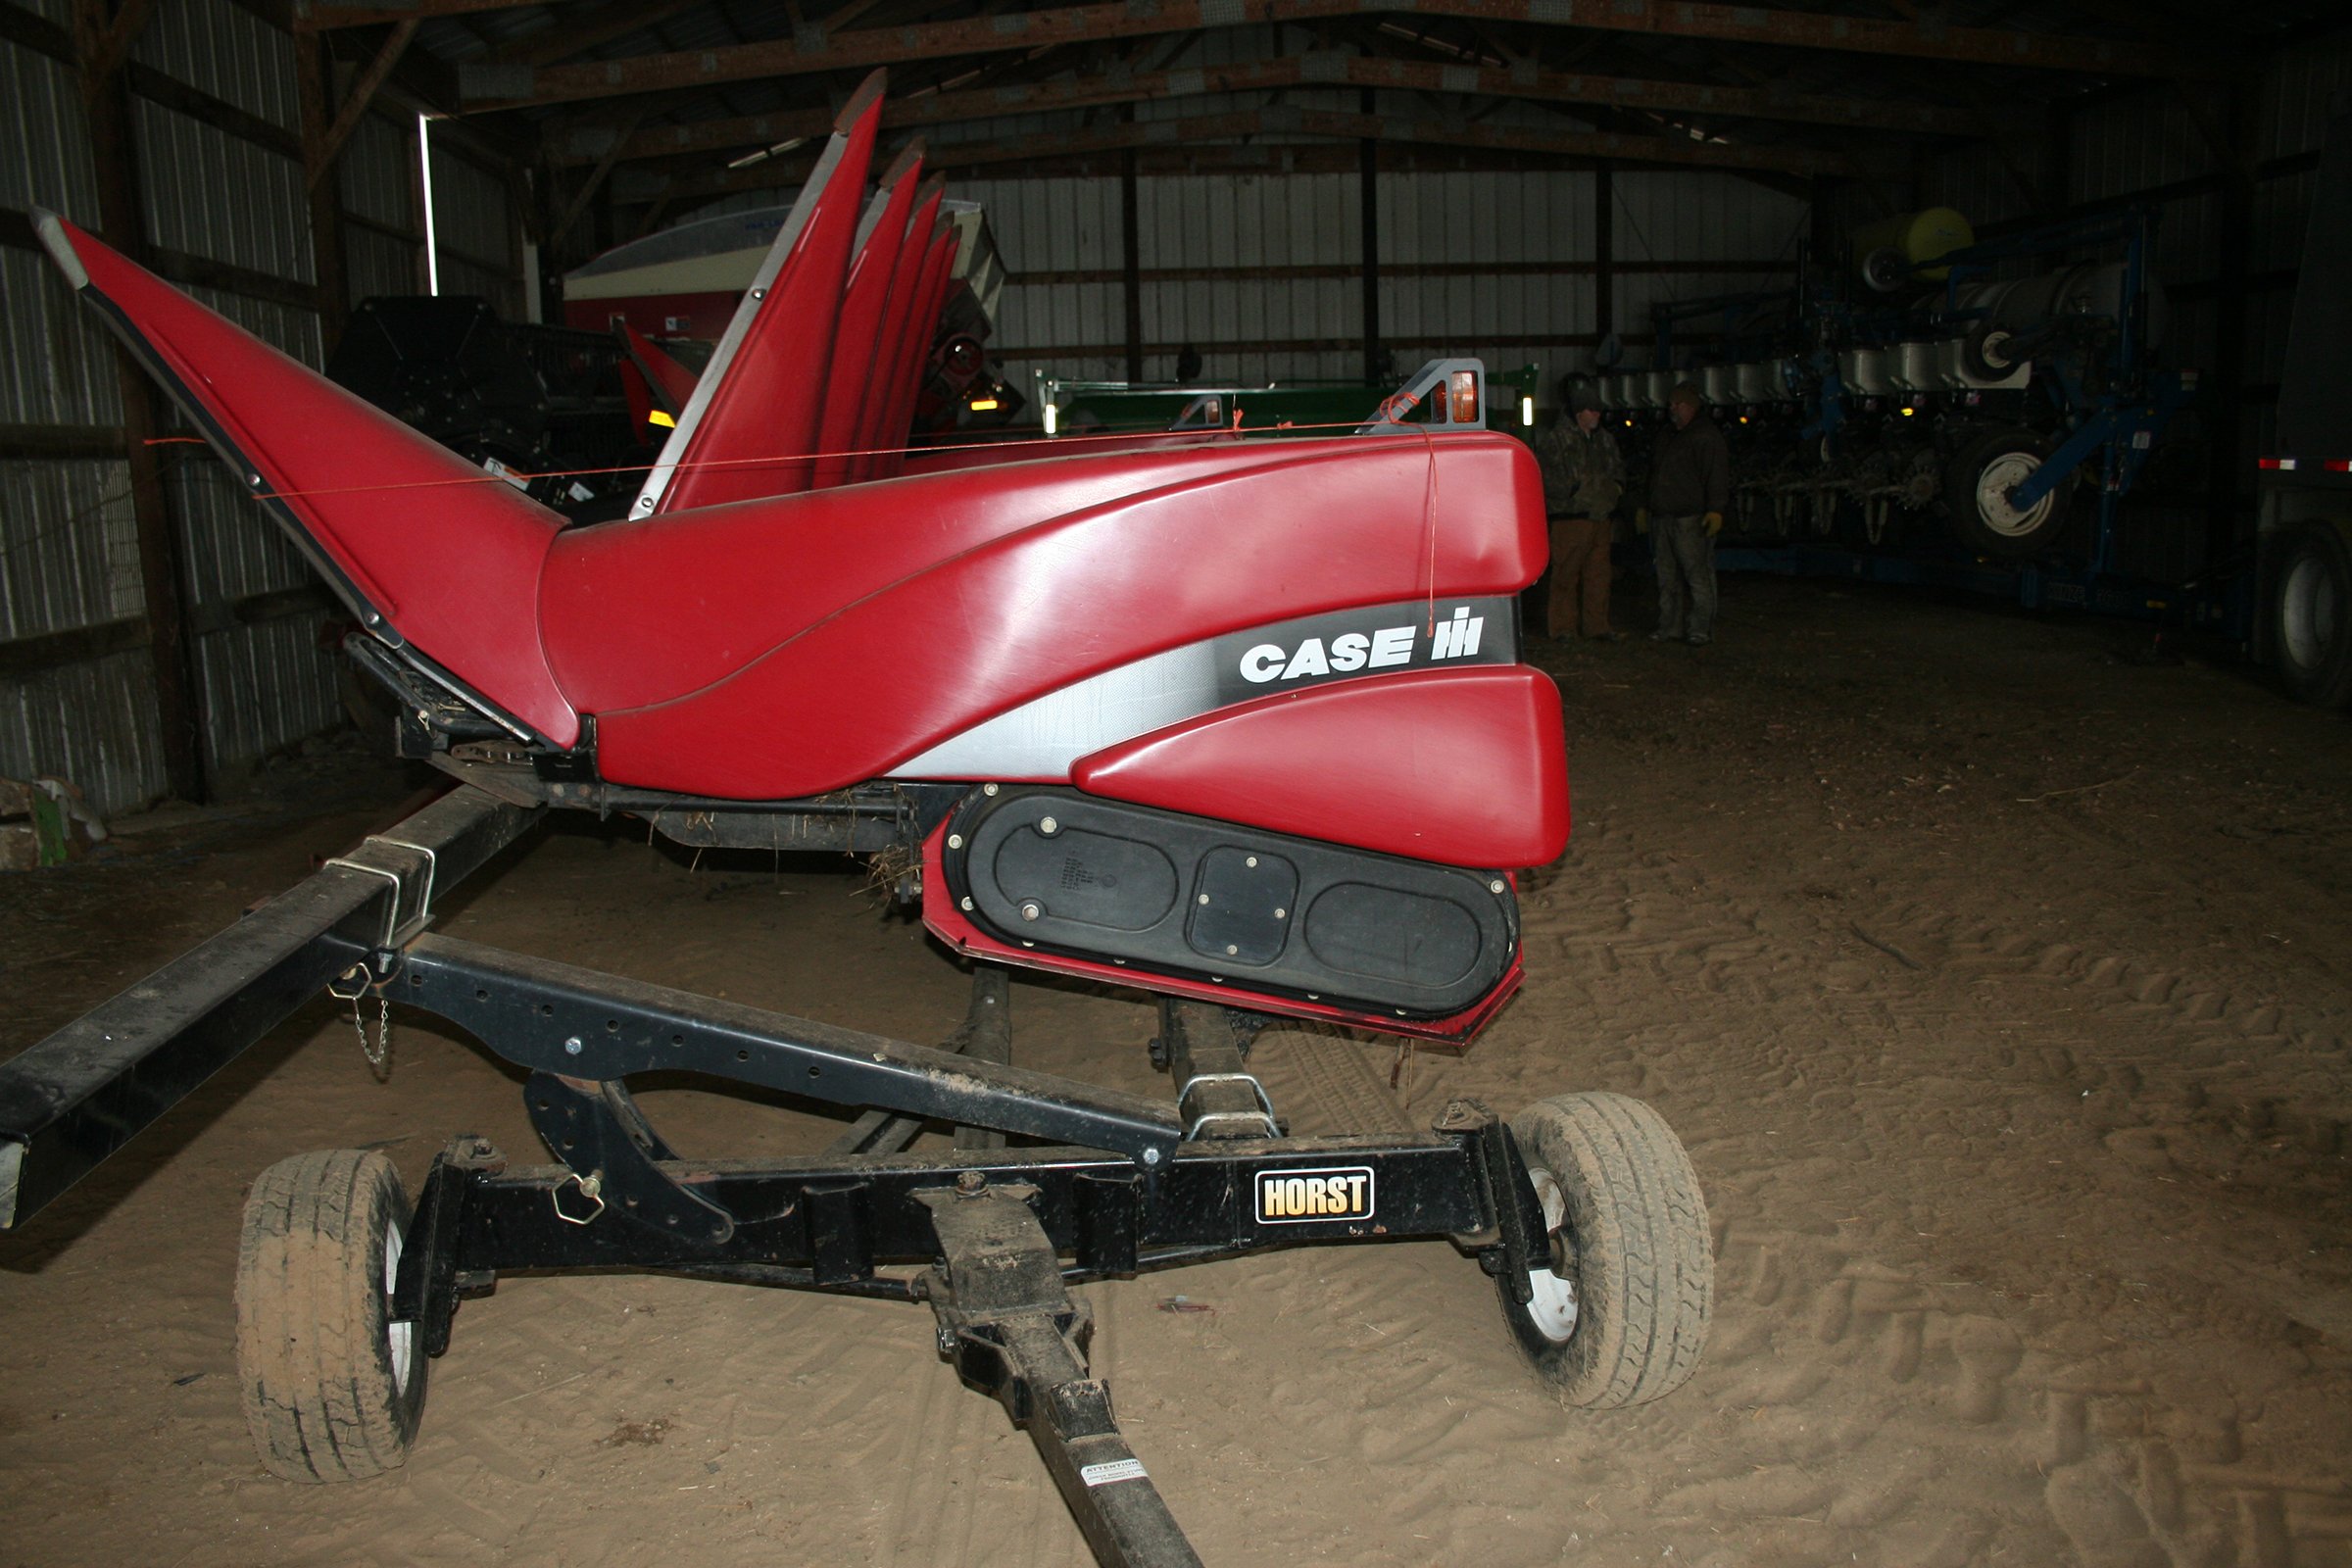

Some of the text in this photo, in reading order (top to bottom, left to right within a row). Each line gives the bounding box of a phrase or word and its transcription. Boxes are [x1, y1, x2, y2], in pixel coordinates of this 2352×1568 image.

[1239, 625, 1417, 683] CASE
[1264, 1176, 1367, 1216] HORST
[1087, 1460, 1139, 1473] ATTENTION
